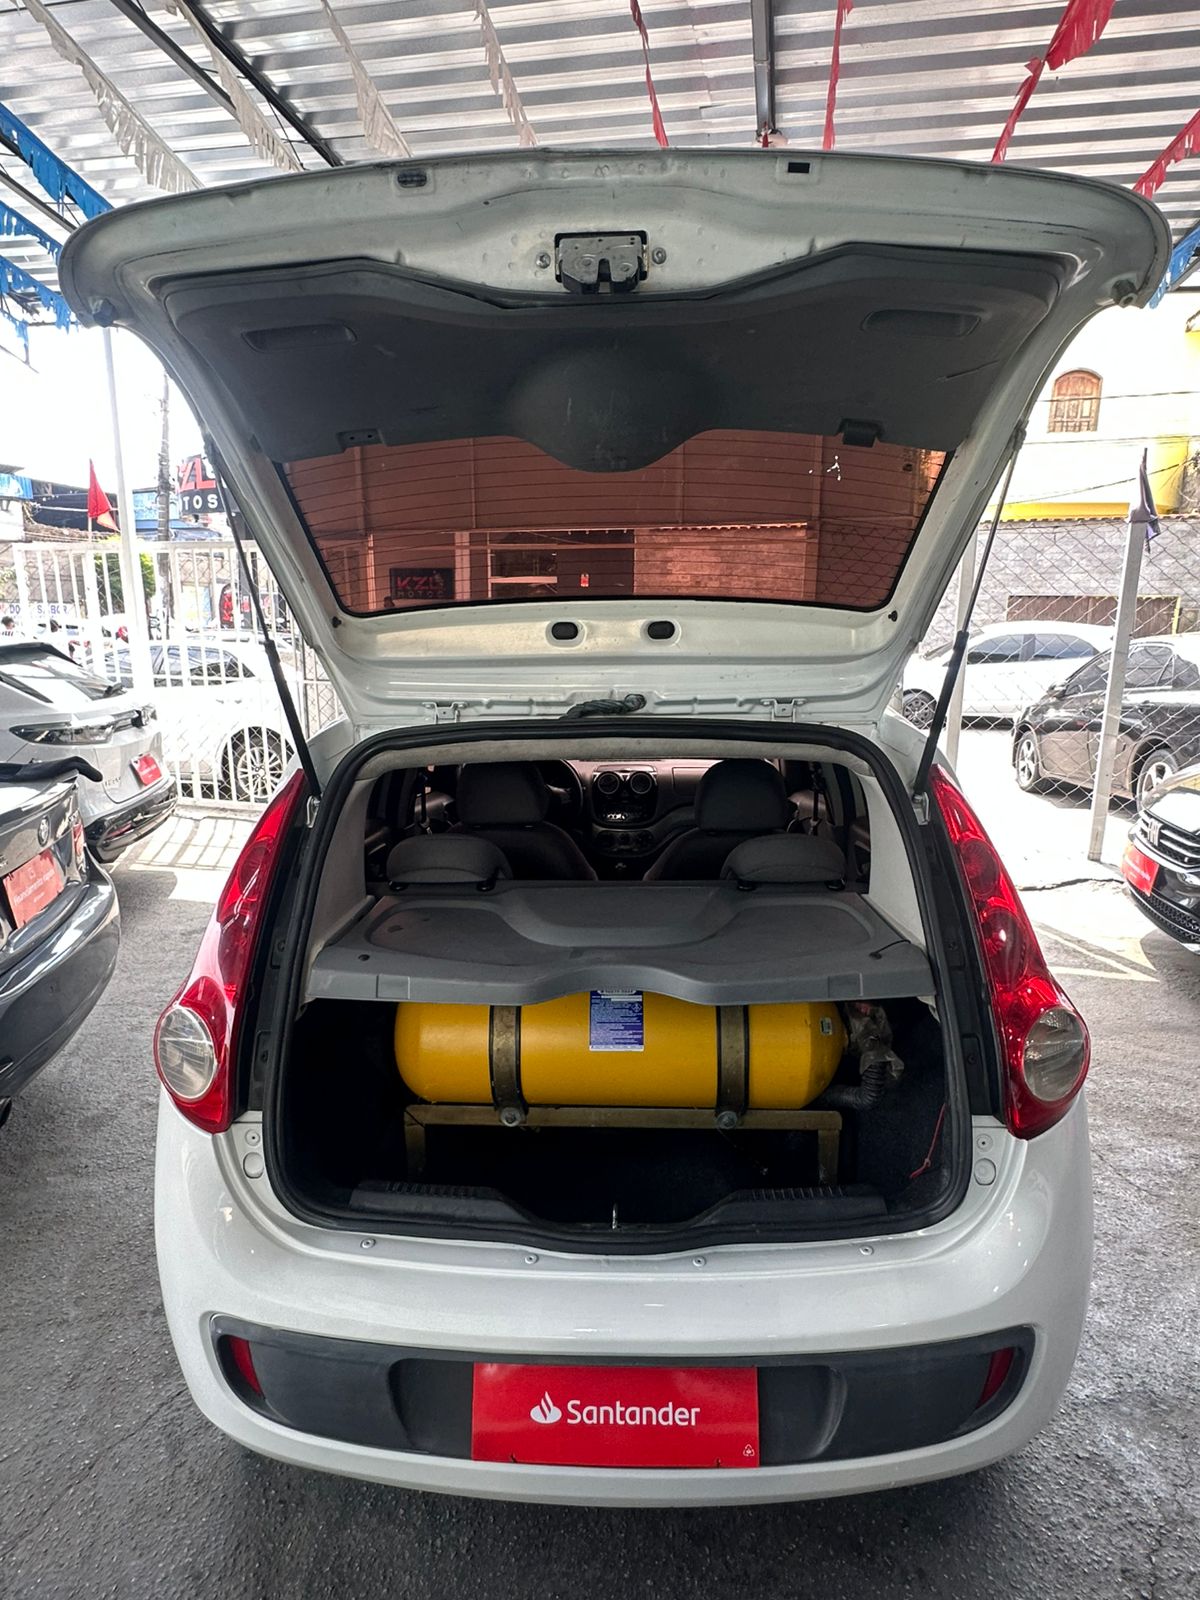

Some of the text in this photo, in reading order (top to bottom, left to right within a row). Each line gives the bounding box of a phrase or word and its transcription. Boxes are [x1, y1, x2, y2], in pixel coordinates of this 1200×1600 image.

[176, 458, 216, 493] ZL
[178, 494, 218, 511] TOS
[567, 1400, 701, 1426] Santander
